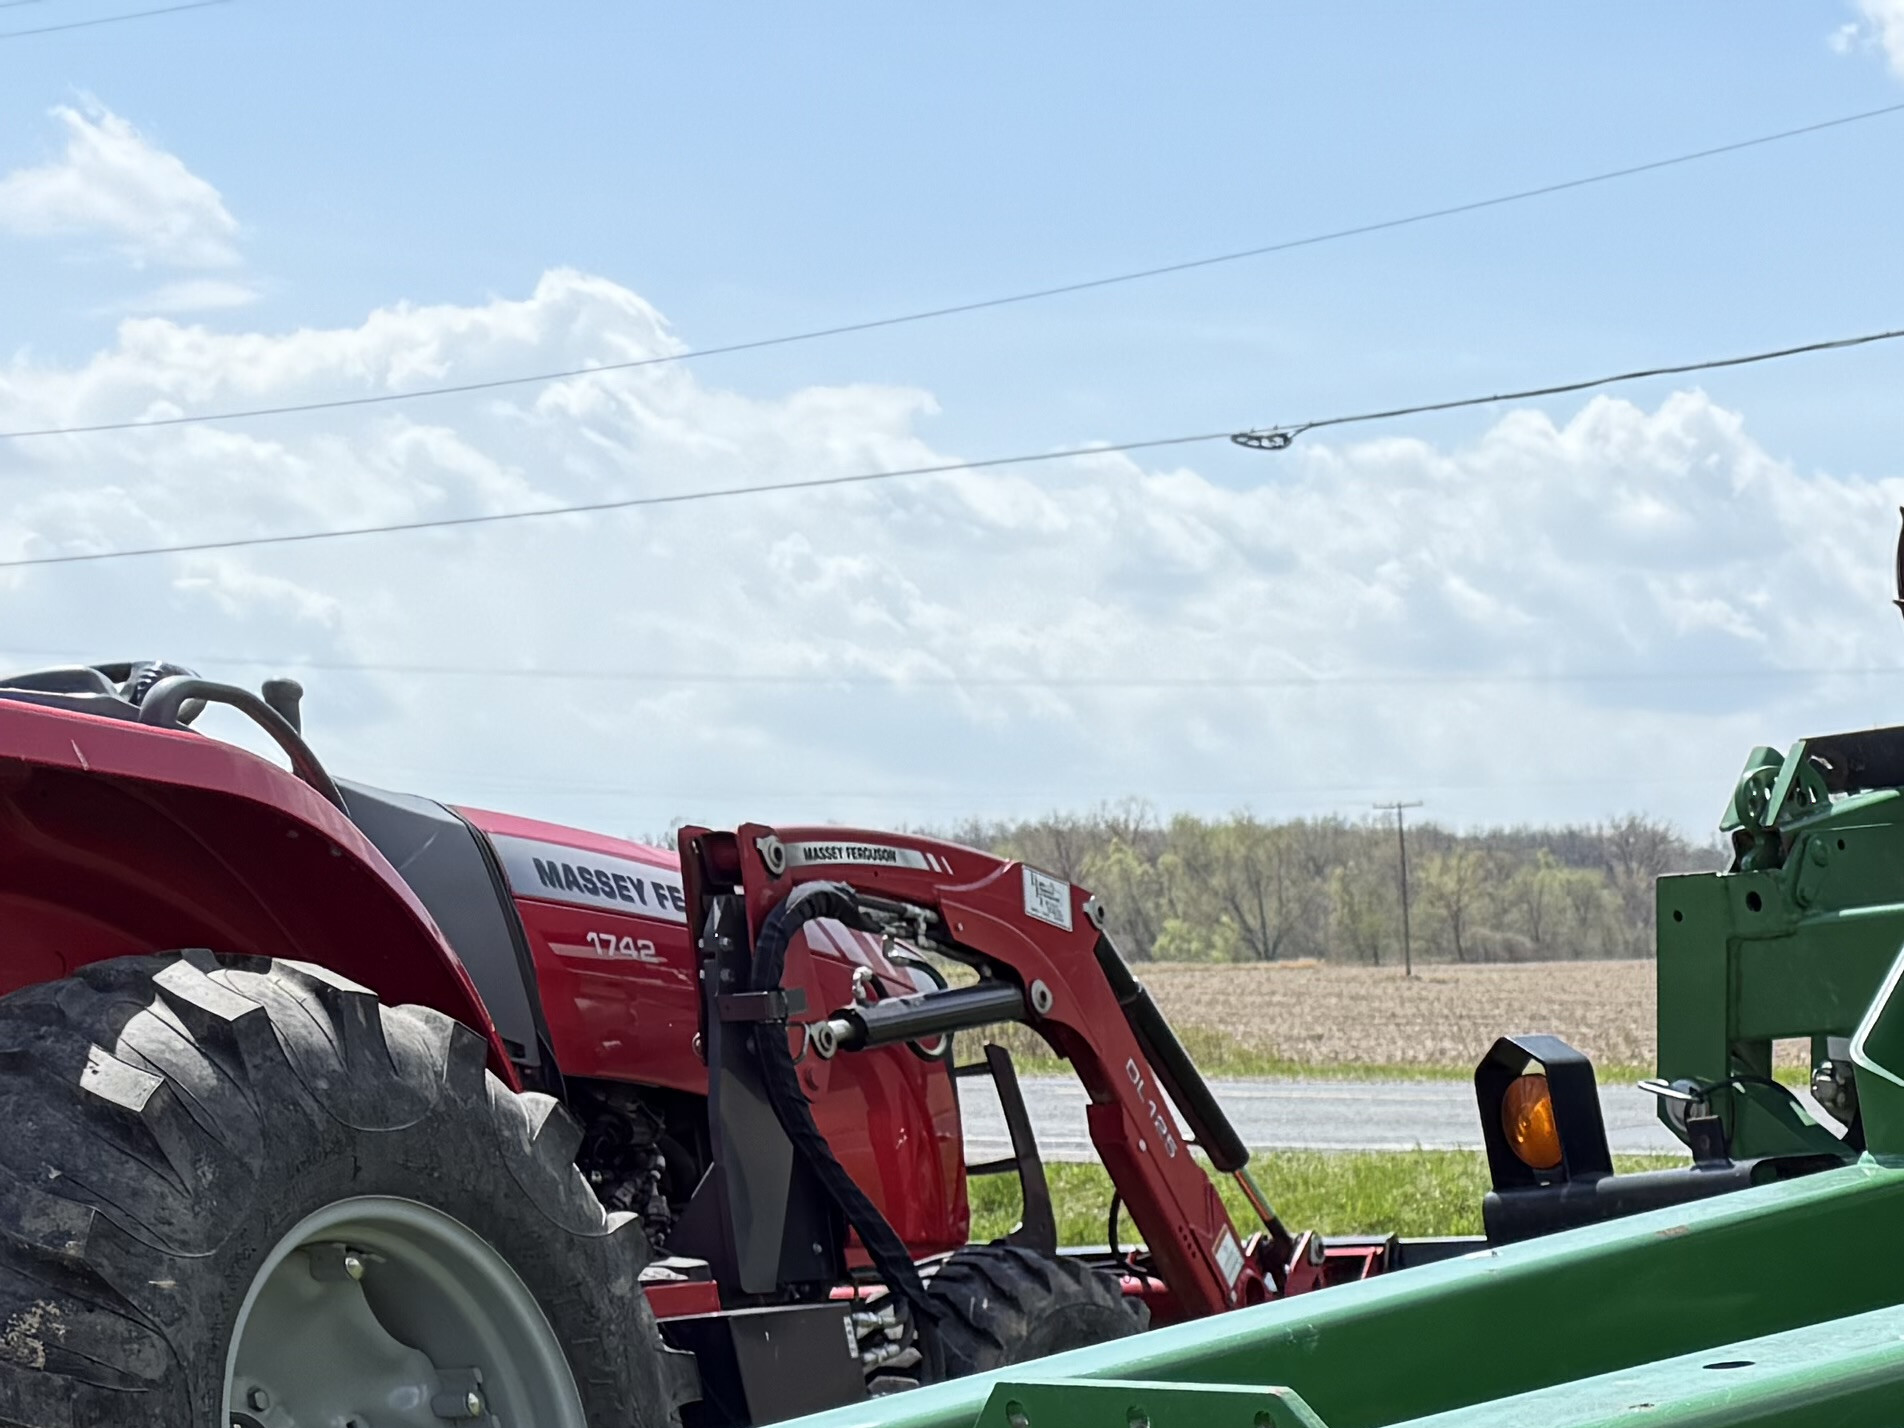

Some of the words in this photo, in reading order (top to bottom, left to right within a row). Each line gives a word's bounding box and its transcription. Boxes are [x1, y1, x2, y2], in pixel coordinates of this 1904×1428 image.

[803, 846, 843, 861] MASSEY
[845, 846, 897, 863] FERGUSON
[532, 857, 647, 906] MASSEY
[587, 932, 657, 962] 1742
